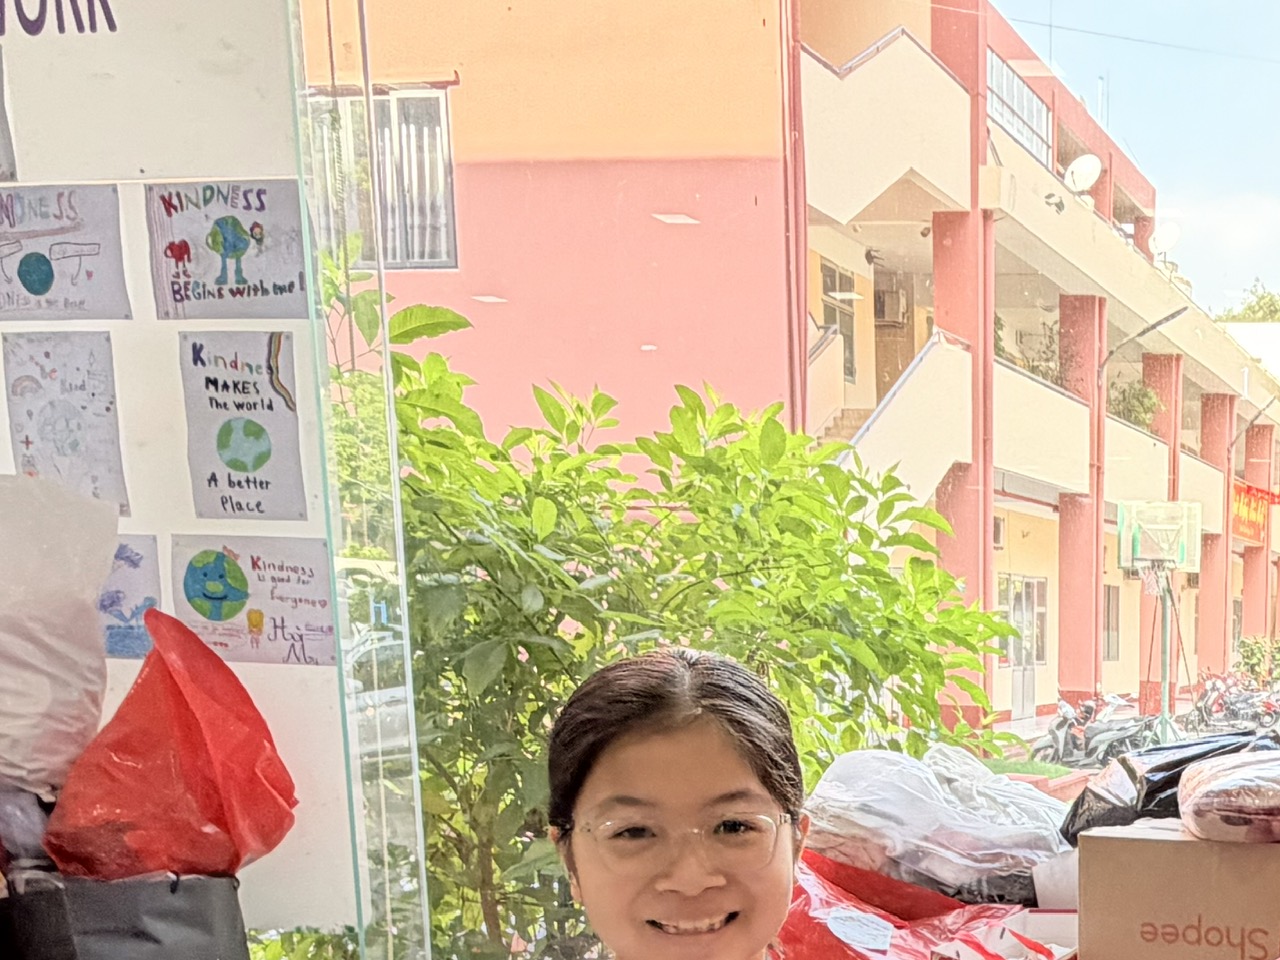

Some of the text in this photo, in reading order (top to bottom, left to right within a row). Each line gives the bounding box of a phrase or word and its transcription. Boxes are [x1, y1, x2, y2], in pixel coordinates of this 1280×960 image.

[159, 184, 268, 218] KINDNESS
[204, 376, 260, 395] MAKES
[209, 396, 229, 411] The
[207, 472, 272, 490] A better
[220, 495, 265, 514] Place
[250, 555, 315, 578] Kindness
